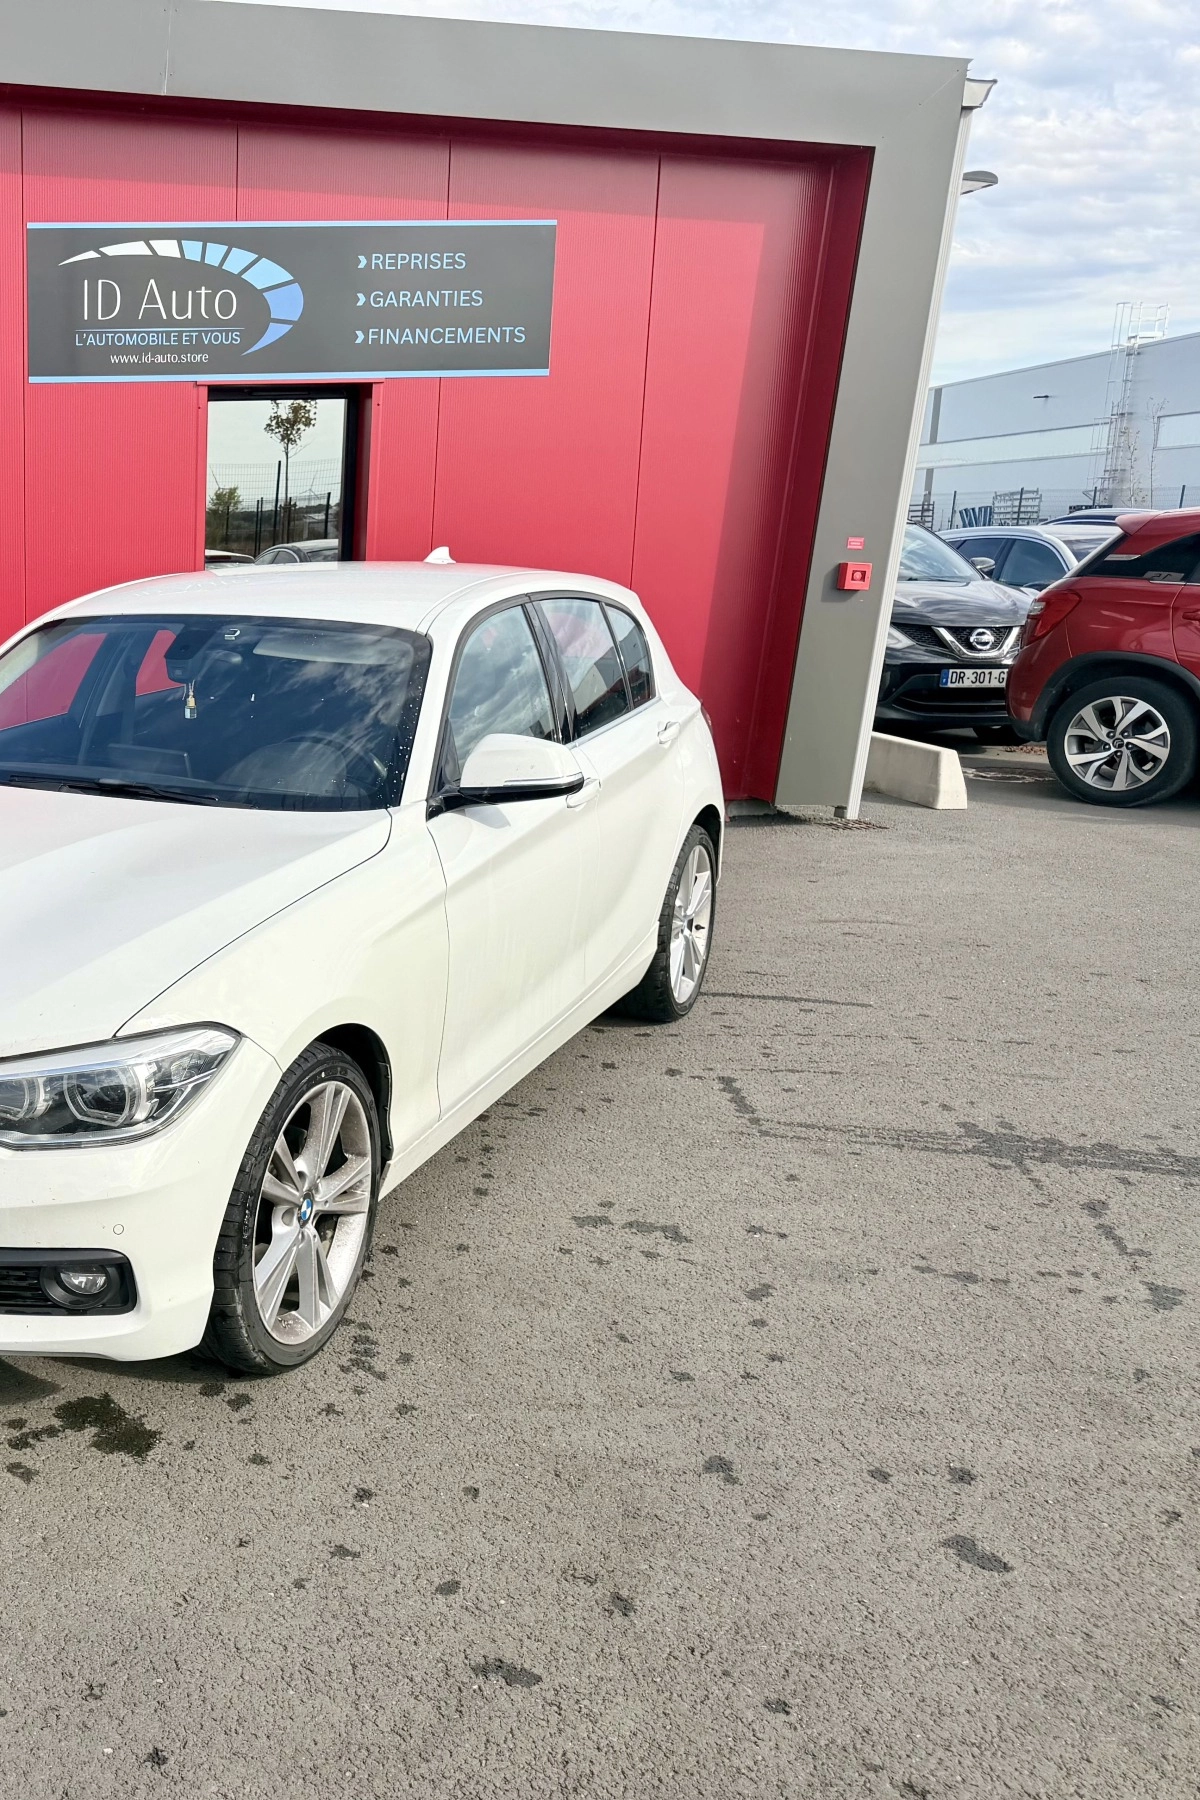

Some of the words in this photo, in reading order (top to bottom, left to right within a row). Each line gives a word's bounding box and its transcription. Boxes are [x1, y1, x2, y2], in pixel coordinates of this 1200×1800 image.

[371, 252, 467, 270] REPRISES
[83, 279, 121, 321] ID
[138, 278, 238, 320] Auto
[369, 290, 483, 308] GARANTIES
[75, 333, 179, 346] L'AUTOMOBILE
[182, 332, 199, 345] ET
[201, 332, 241, 345] VOUS
[368, 327, 526, 345] FINANCEMENTS
[110, 351, 209, 364] www.id-auto.store
